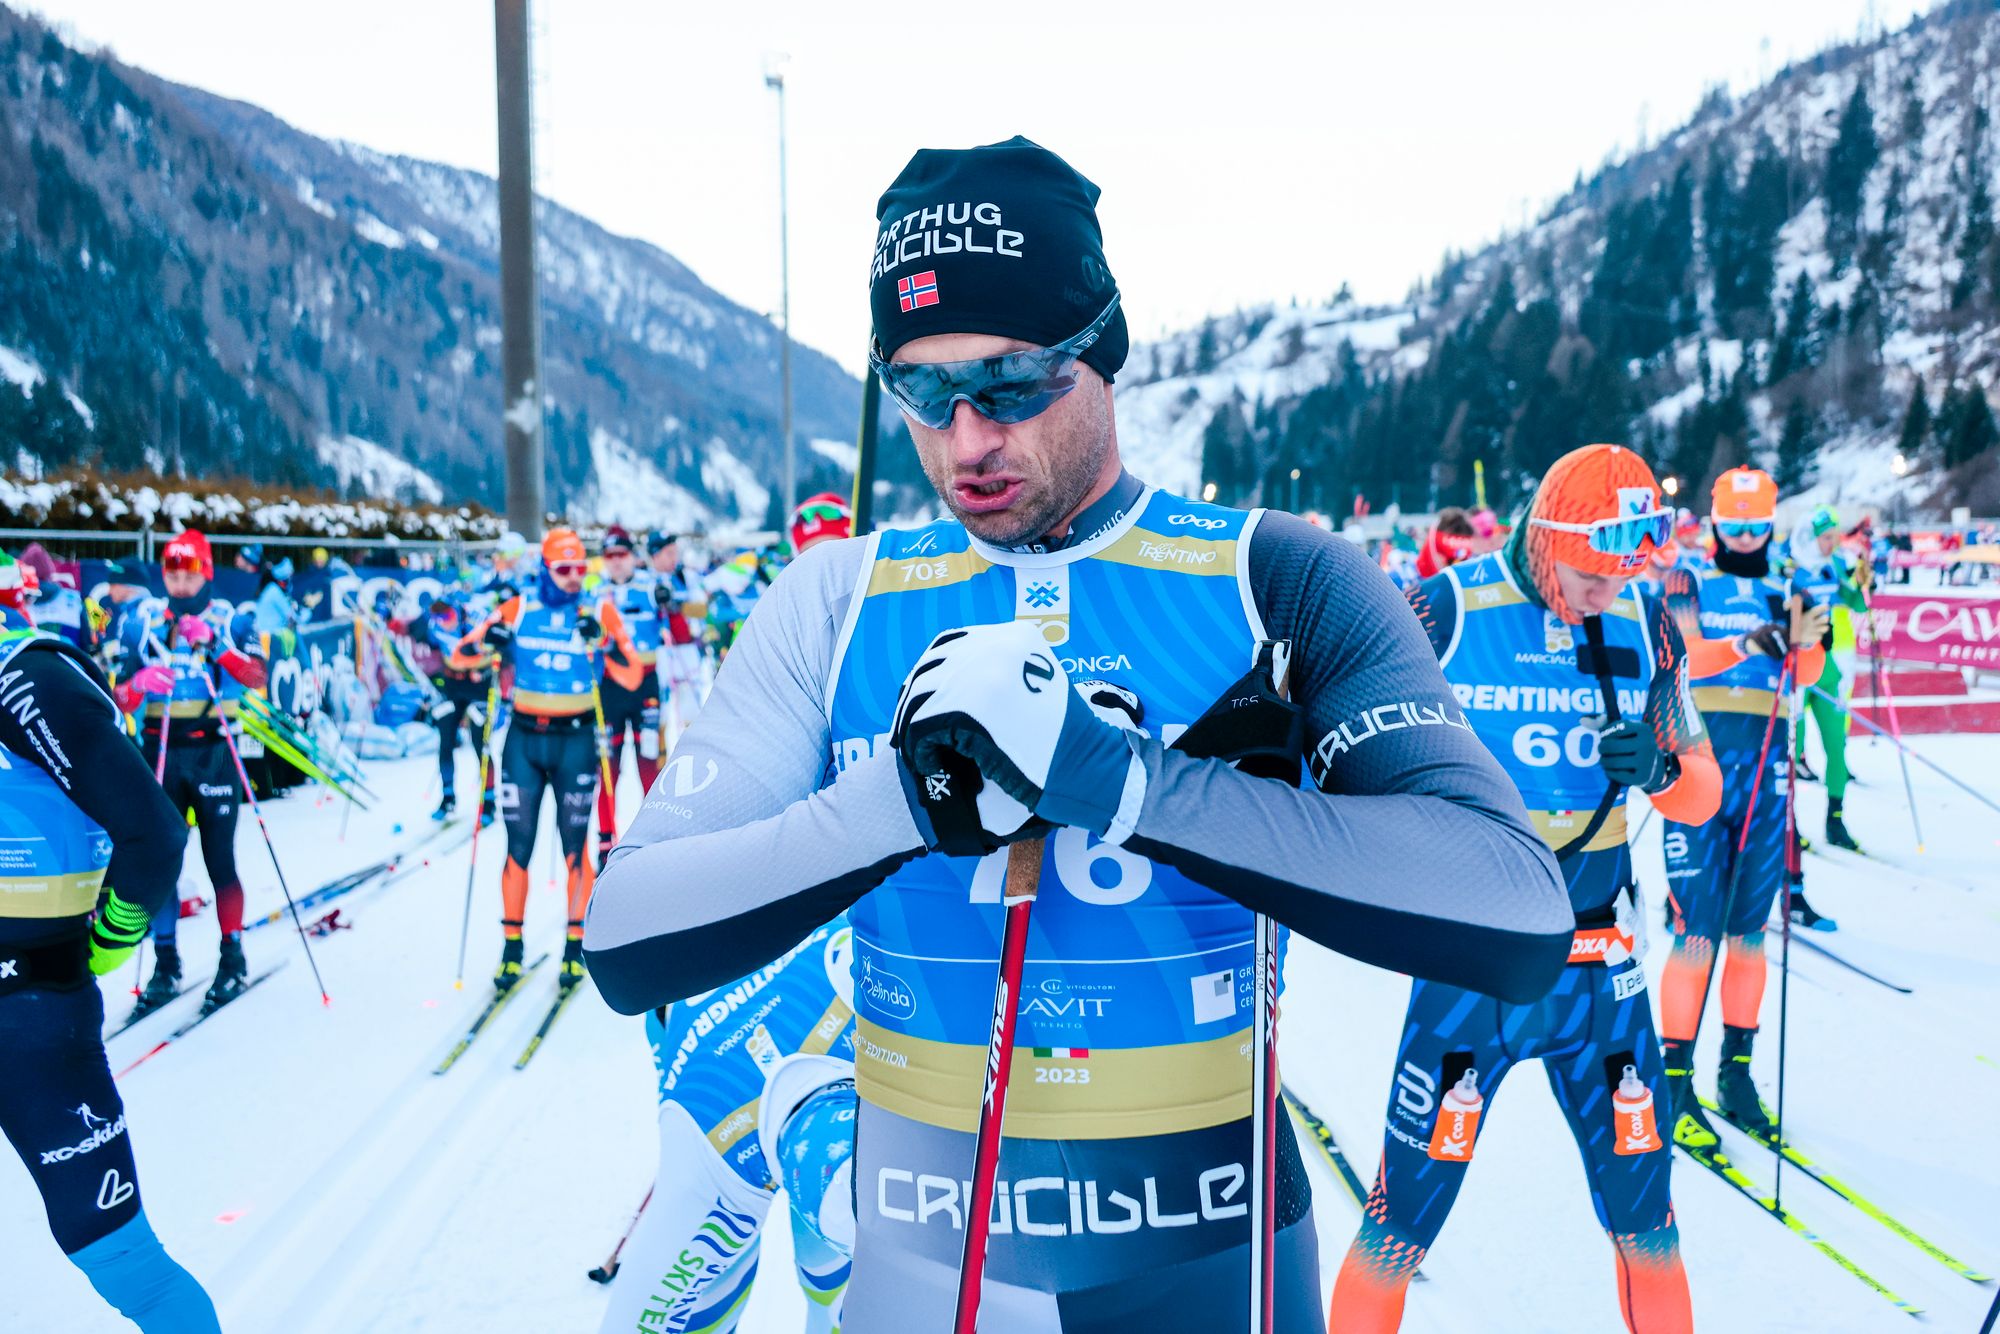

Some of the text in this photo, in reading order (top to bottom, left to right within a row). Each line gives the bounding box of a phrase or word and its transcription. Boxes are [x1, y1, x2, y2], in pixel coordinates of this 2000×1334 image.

[870, 227, 1024, 283] RUCIBLE
[1512, 723, 1601, 768] 60
[1018, 996, 1113, 1018] AVIT
[1035, 1067, 1091, 1084] 2023
[661, 1249, 705, 1293] SKI
